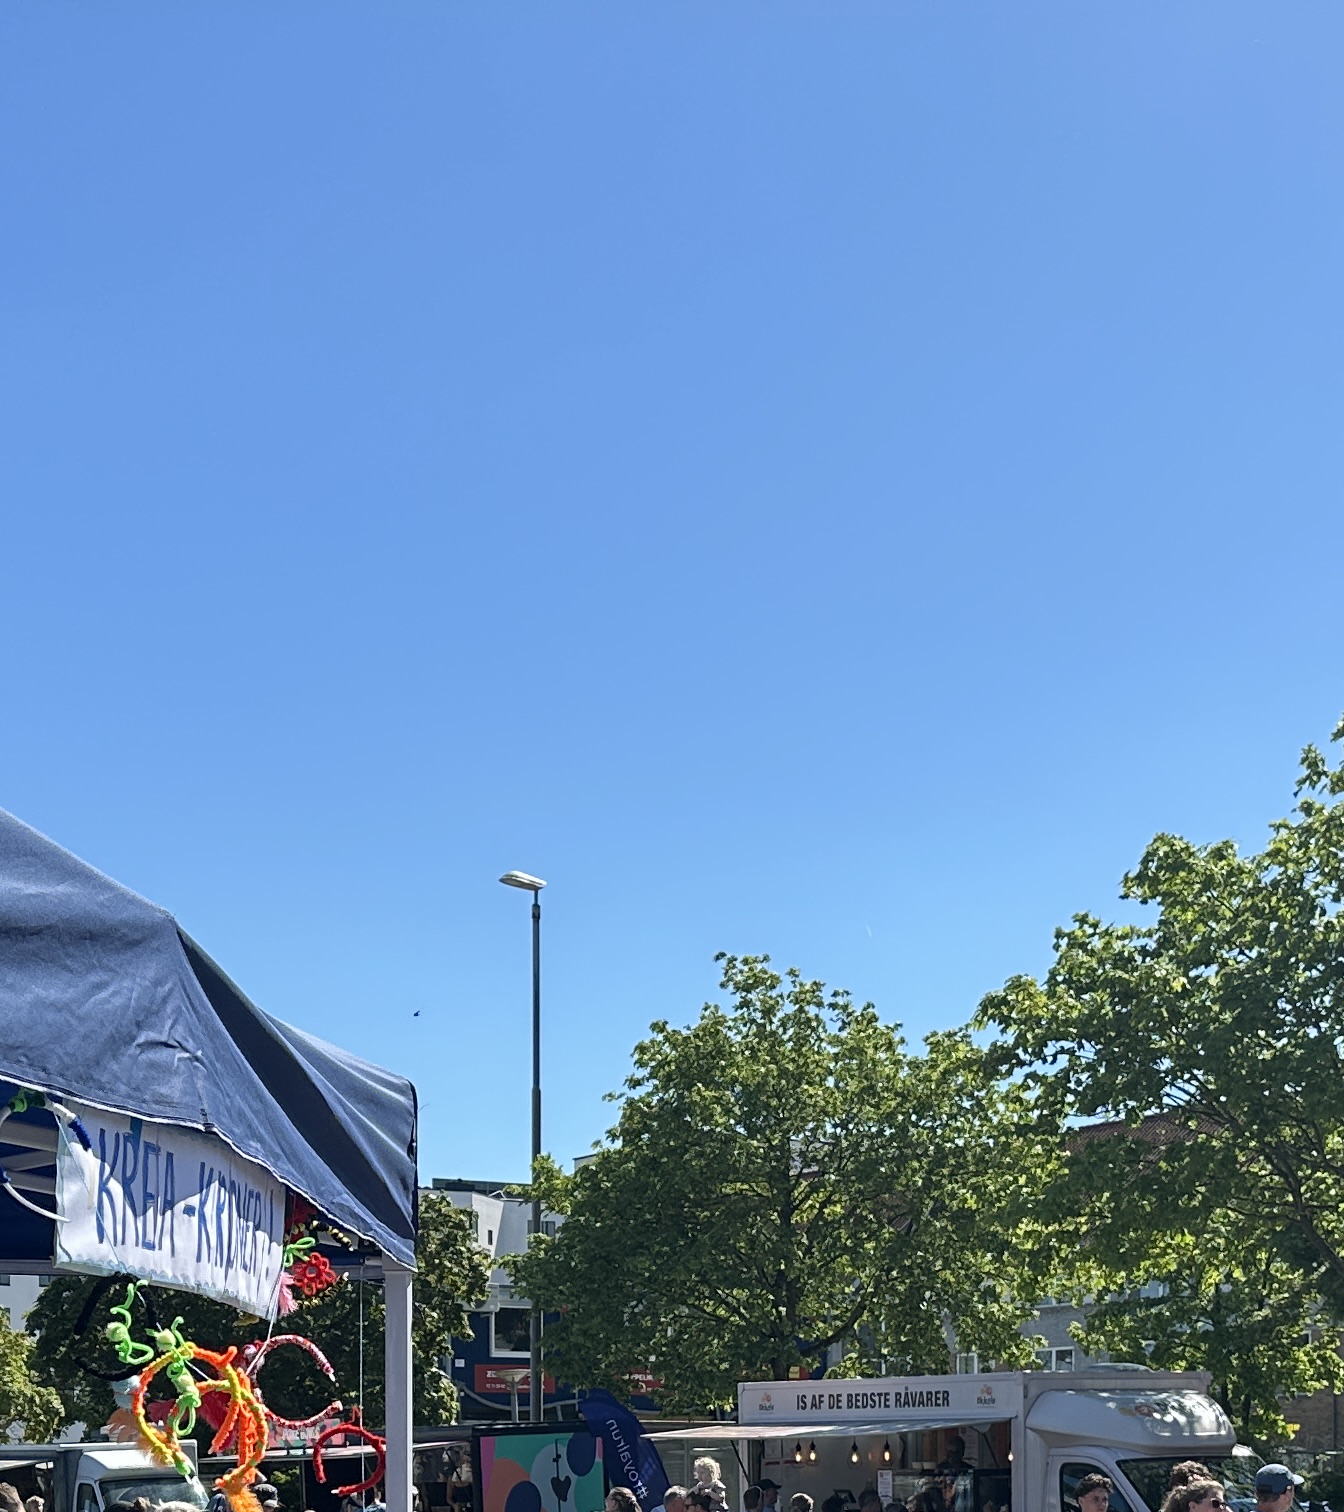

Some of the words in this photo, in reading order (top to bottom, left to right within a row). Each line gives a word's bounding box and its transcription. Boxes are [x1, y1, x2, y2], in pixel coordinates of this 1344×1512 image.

[796, 1394, 808, 1411] IS
[810, 1394, 825, 1410] AF
[828, 1393, 843, 1410] DE
[846, 1392, 891, 1410] BEDSTE
[894, 1386, 950, 1408] RÅVARER
